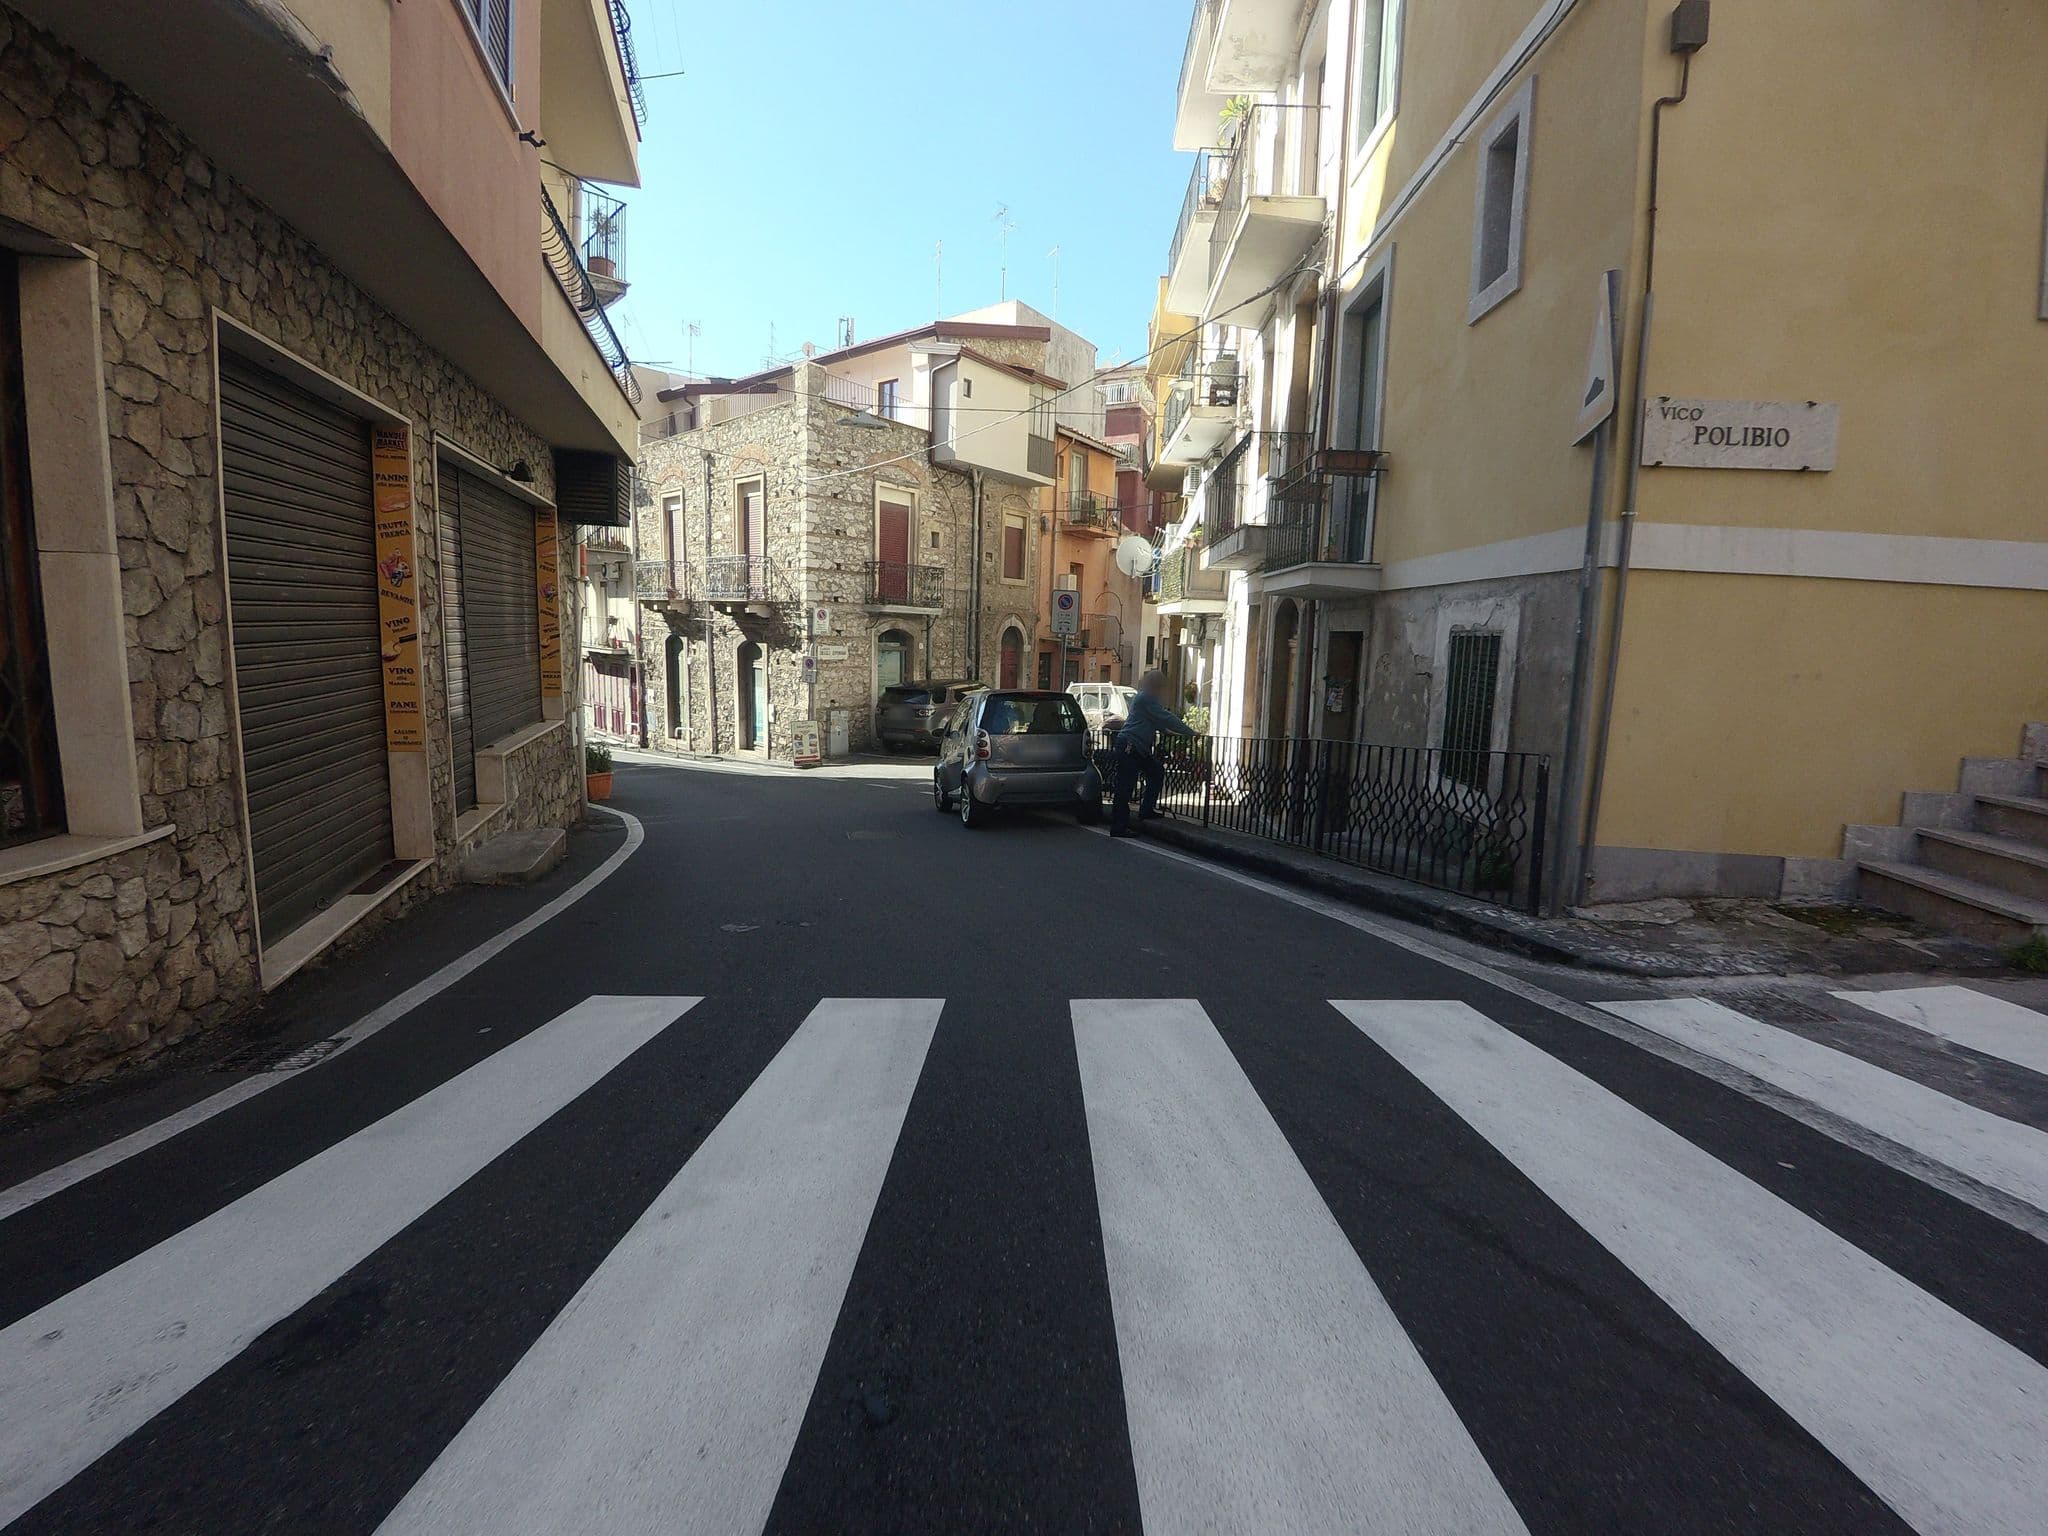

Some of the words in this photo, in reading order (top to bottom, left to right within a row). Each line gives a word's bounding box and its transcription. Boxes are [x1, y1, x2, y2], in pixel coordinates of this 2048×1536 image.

[1660, 406, 1704, 421] VICO
[1693, 425, 1790, 447] POLIBIO
[375, 472, 408, 482] PANINI
[378, 520, 409, 530] FRUTTA
[380, 529, 411, 539] FRESCA
[384, 616, 410, 629] VINO
[388, 667, 415, 675] VINO
[390, 701, 418, 709] PANE
